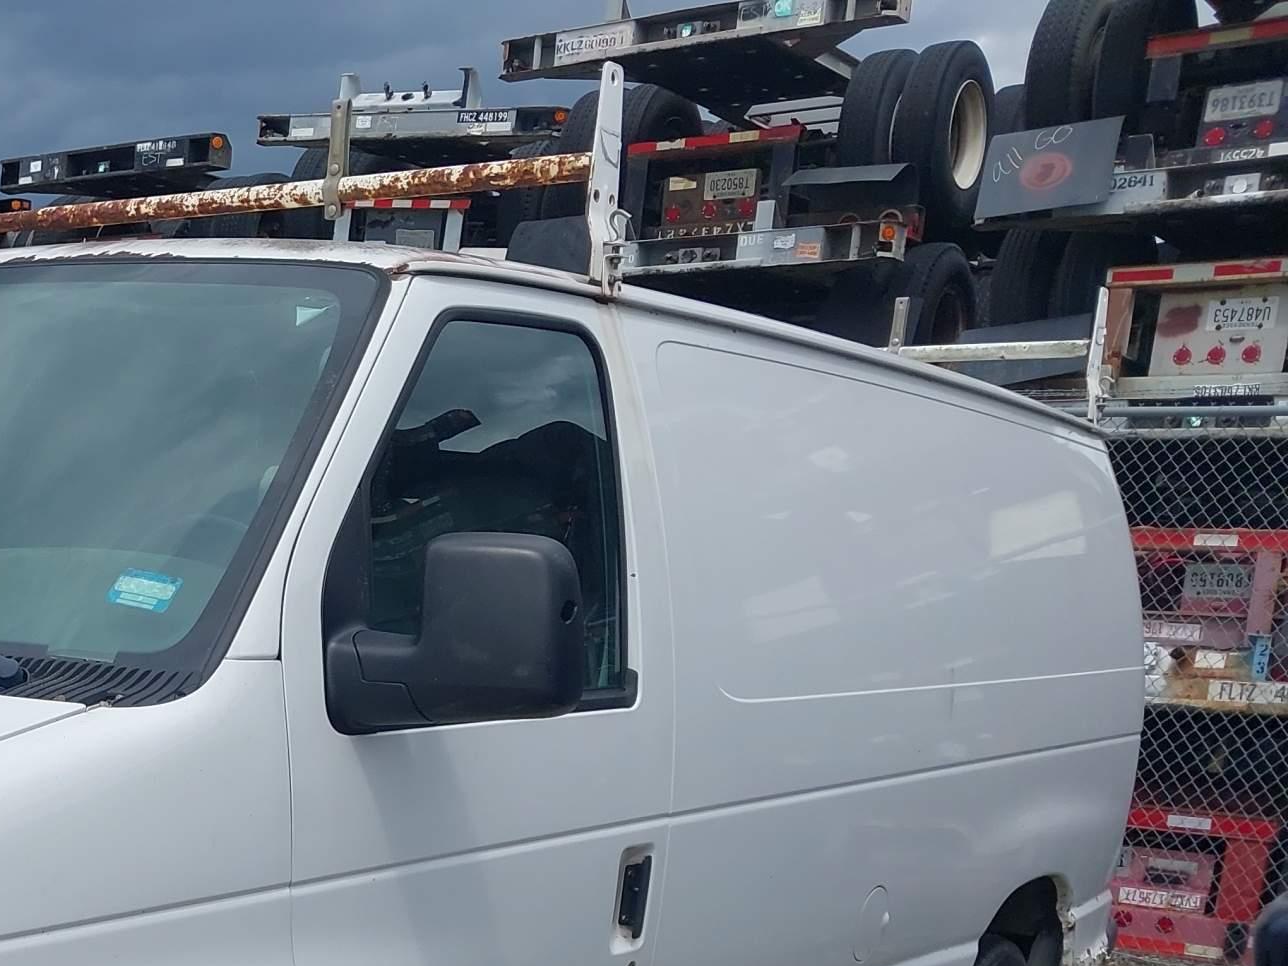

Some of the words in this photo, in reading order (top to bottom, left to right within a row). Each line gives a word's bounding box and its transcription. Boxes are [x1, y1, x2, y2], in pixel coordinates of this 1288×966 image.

[1212, 91, 1274, 113] T393186
[459, 111, 477, 122] FHCZ
[478, 111, 508, 122] 448199
[710, 177, 750, 191] T850230
[736, 232, 765, 248] DUE
[1214, 306, 1271, 323] U487453
[1219, 682, 1257, 701] FLTZ
